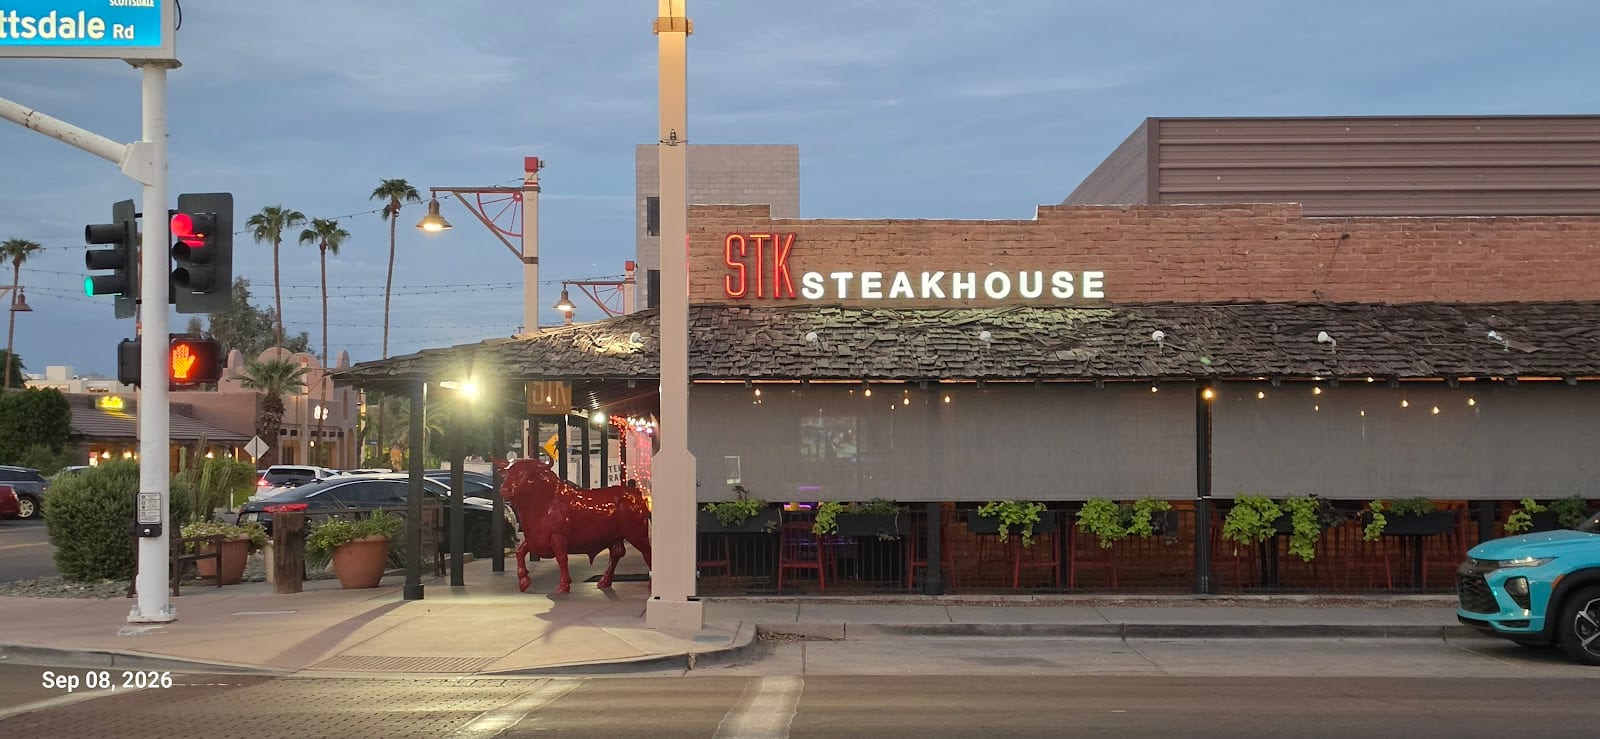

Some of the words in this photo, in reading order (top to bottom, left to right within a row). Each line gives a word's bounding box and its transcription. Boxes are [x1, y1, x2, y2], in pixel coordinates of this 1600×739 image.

[113, 23, 135, 39] Rd
[724, 232, 796, 298] STK
[801, 271, 1105, 299] STEAKHOUSE
